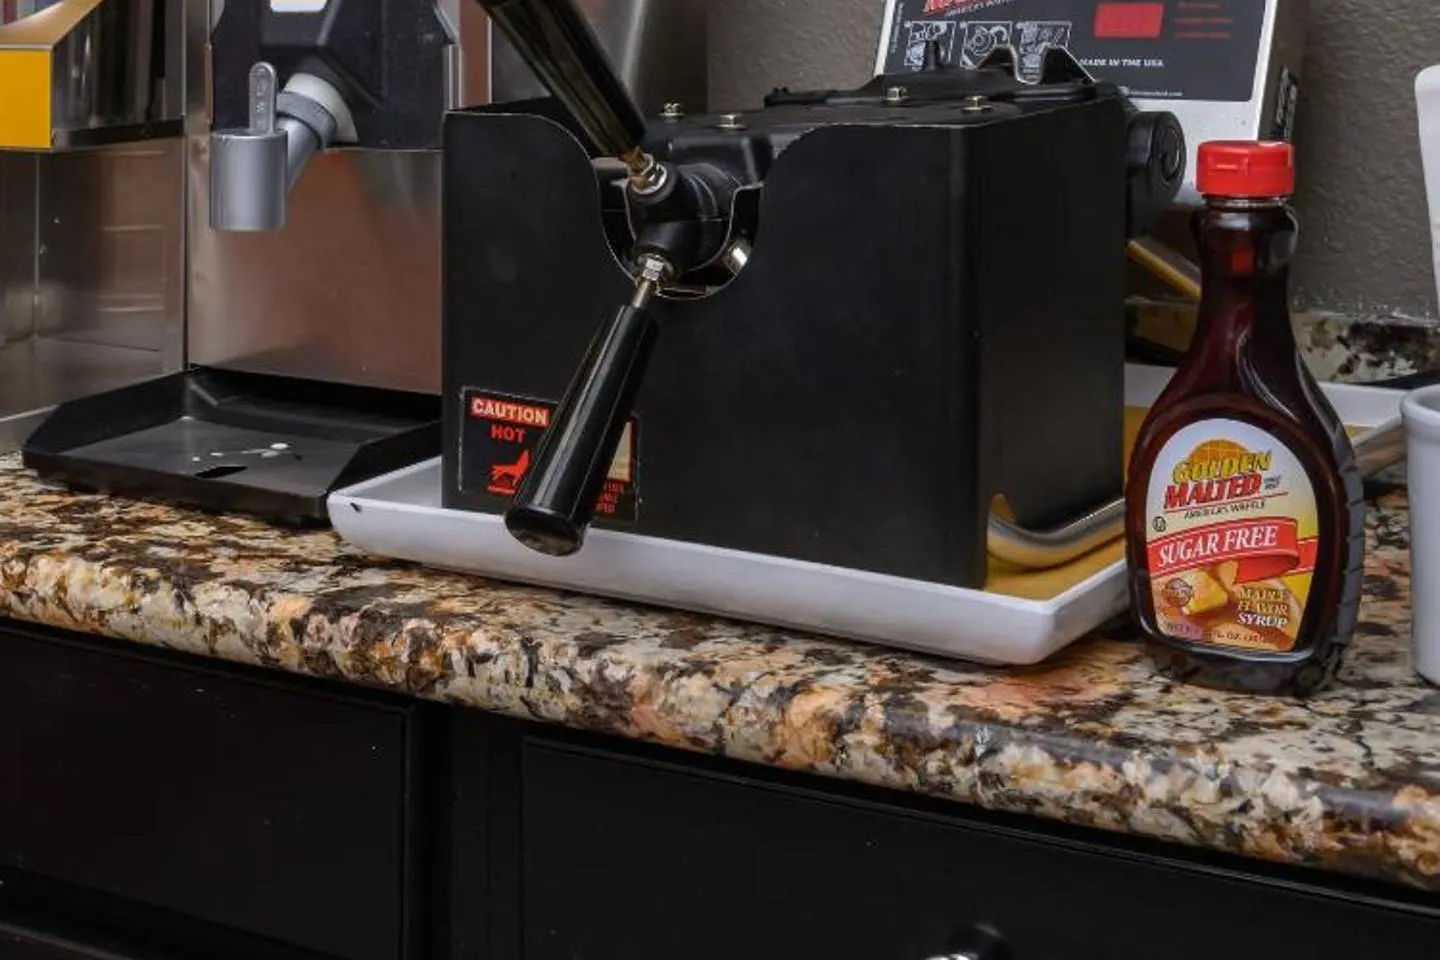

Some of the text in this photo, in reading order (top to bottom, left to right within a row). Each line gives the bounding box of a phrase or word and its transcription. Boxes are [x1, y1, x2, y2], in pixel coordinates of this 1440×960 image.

[471, 397, 549, 426] CAUTION
[490, 424, 527, 444] HOT
[1172, 450, 1273, 485] GOLDEN
[1163, 471, 1263, 510] MALTED
[1158, 525, 1279, 567] SUGAR FREE
[1237, 613, 1289, 628] SYRUP
[1238, 601, 1289, 615] FLAVOR
